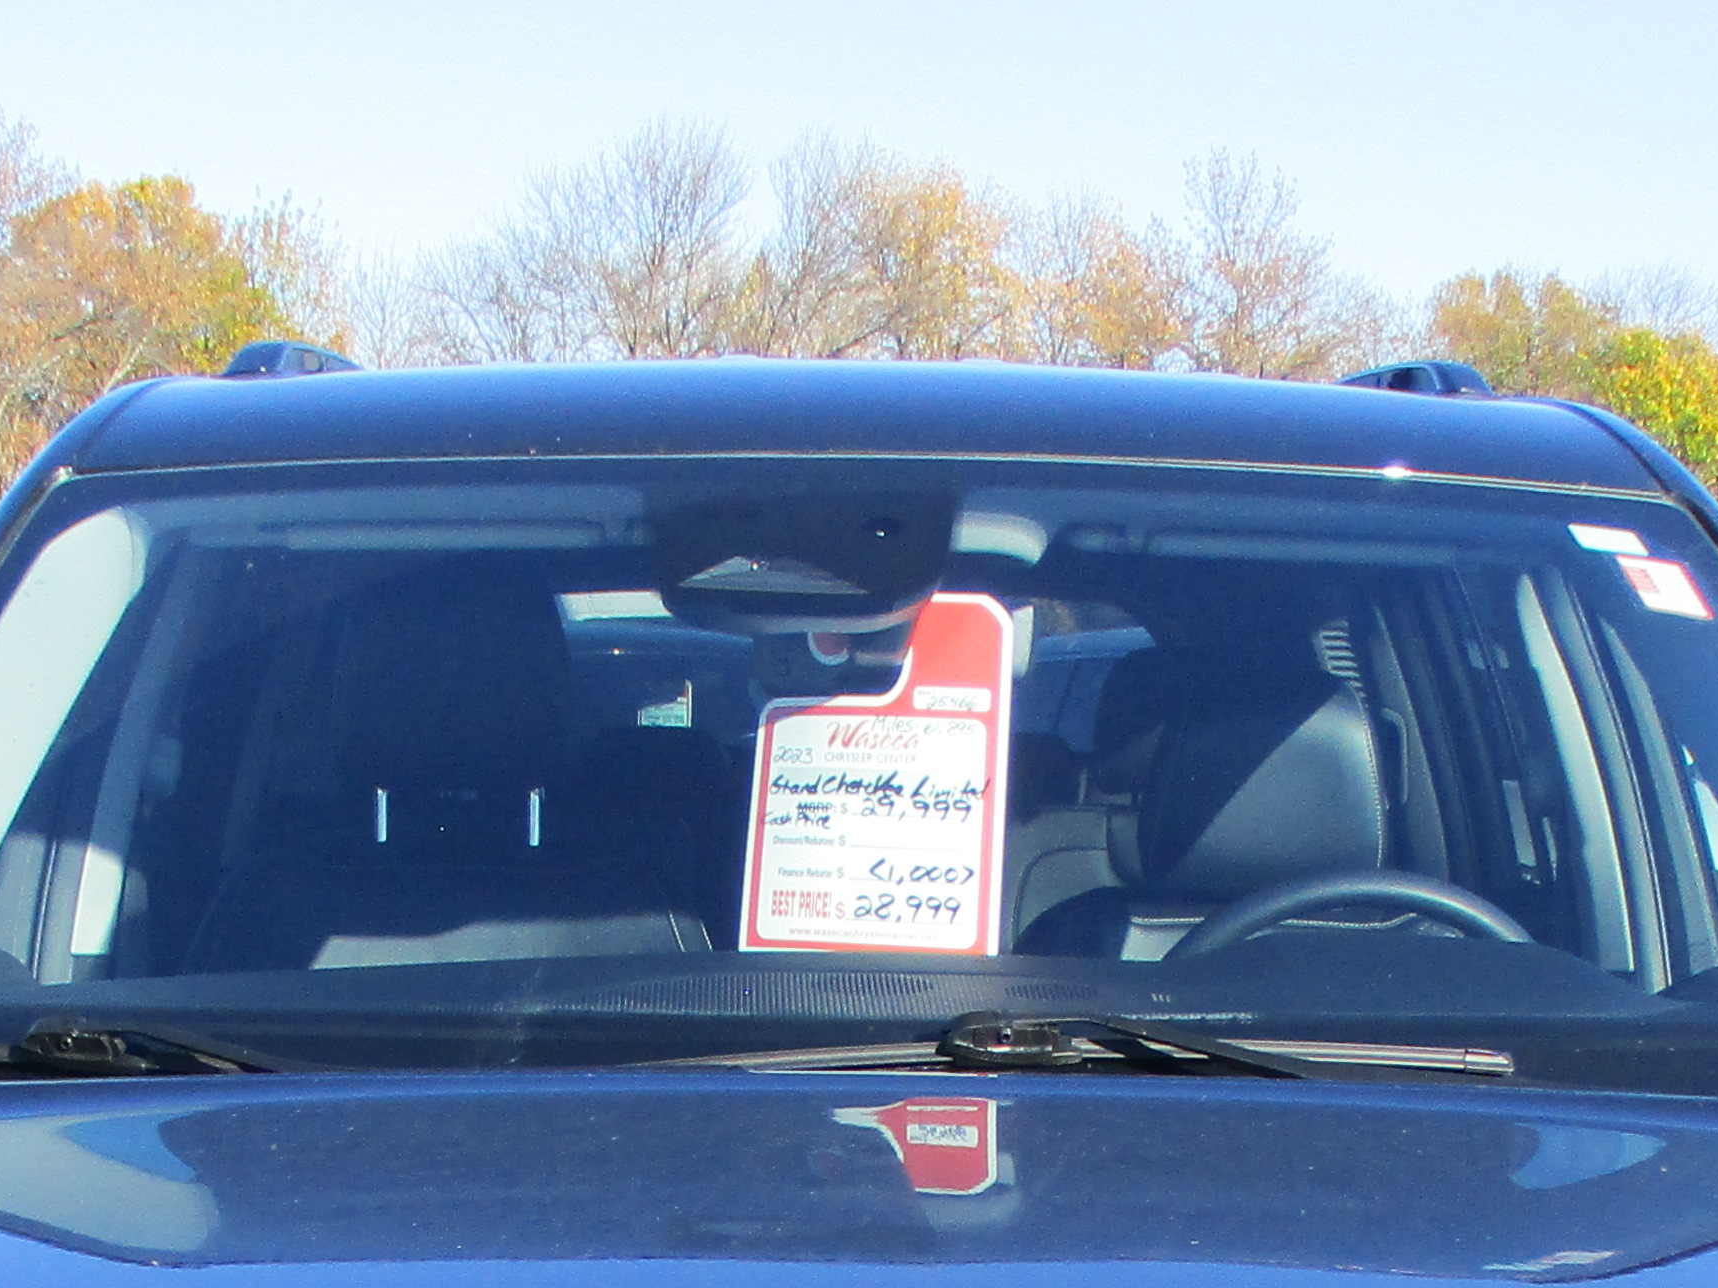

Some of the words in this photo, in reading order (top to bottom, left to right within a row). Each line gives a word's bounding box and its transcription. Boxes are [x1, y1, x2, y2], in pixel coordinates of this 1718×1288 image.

[773, 746, 814, 765] 2023
[824, 752, 873, 763] CHRYSLER
[876, 753, 917, 764] CENTER
[861, 795, 972, 822] 29,999
[838, 834, 846, 847] $
[836, 867, 845, 878] $
[771, 890, 797, 917] BEST
[799, 891, 832, 918] PRICE!
[835, 901, 845, 920] $
[853, 893, 962, 925] 28,999
